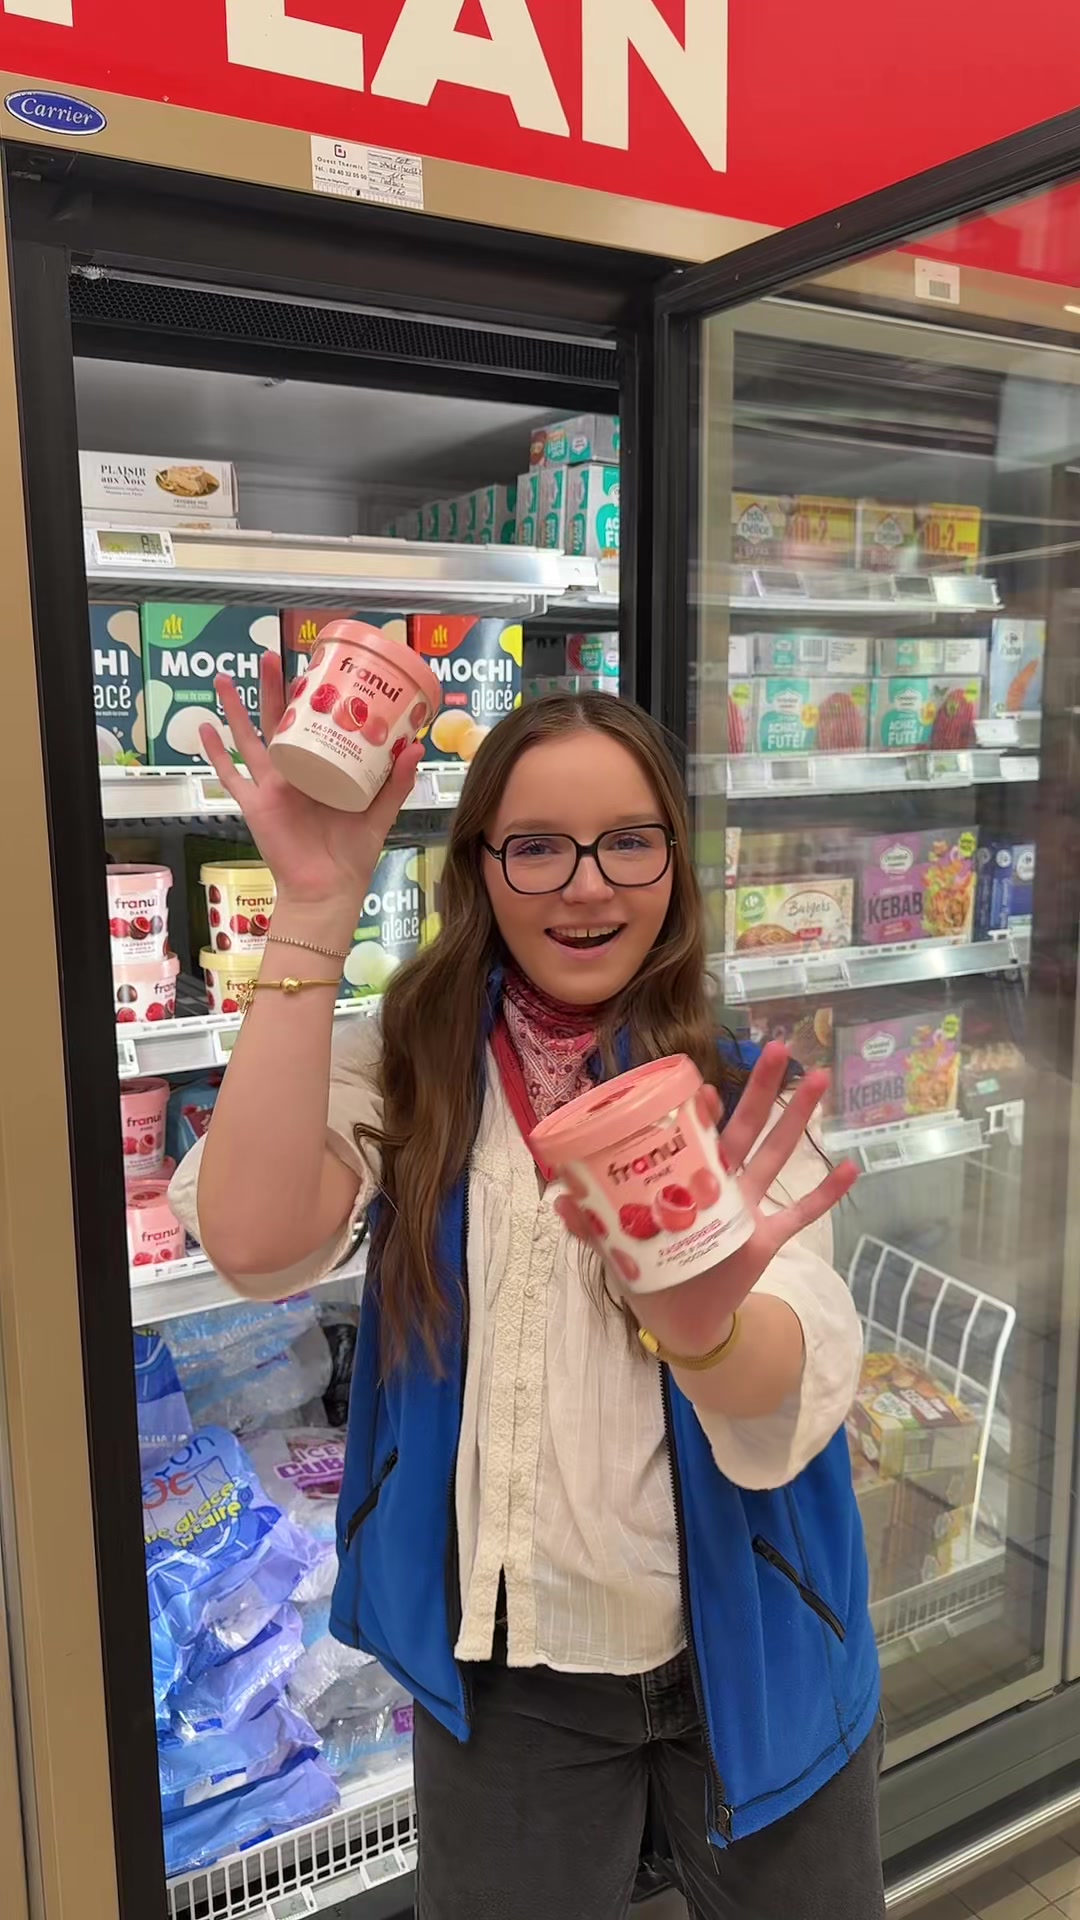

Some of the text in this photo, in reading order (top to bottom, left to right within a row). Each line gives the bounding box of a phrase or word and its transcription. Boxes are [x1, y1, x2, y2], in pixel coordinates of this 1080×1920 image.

[21, 98, 92, 124] Carrier
[317, 157, 336, 165] Ouest
[338, 160, 363, 170] Thermic
[101, 464, 146, 477] PLAISIR
[123, 475, 146, 486] Noix
[161, 650, 264, 679] MOCH
[429, 657, 513, 682] MOCHI
[339, 657, 403, 703] franui
[352, 682, 376, 699] PINK
[471, 684, 513, 717] glacé
[311, 722, 363, 754] RASPBERRIES
[315, 738, 347, 760] CHOCOLATE
[335, 740, 363, 763] RASPBERRY
[114, 896, 158, 909] franui
[236, 895, 273, 907] franu
[360, 888, 419, 917] OCHI
[868, 891, 923, 925] KEBAB
[382, 911, 419, 948] glacé
[850, 1076, 905, 1111] KEBAB
[607, 1127, 687, 1185] franui
[298, 1445, 339, 1460] ICE
